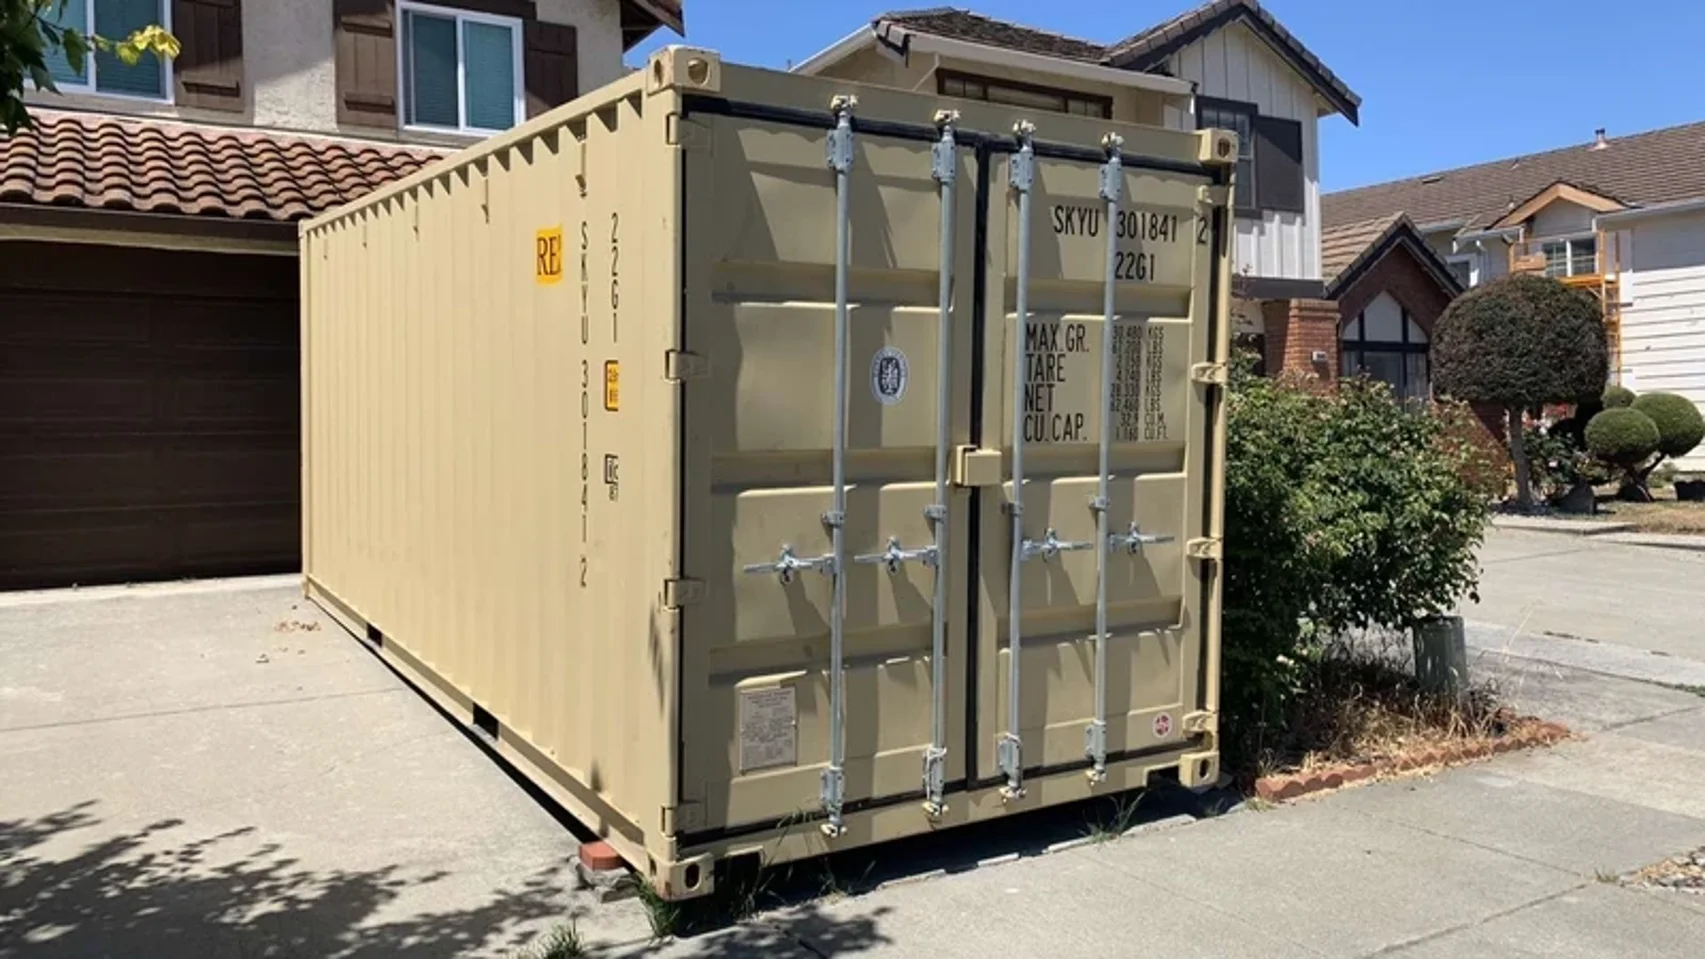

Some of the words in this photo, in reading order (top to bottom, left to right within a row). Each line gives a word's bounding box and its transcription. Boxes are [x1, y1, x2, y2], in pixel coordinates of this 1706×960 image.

[1053, 204, 1100, 238] SKYU
[1116, 210, 1178, 243] 301841
[1197, 216, 1208, 245] 2
[581, 220, 589, 345] SKYU
[611, 211, 619, 343] 22G1
[1114, 251, 1155, 281] 22G1
[1025, 353, 1067, 382] TARE
[1024, 383, 1056, 412] NET
[581, 359, 589, 543] 301841
